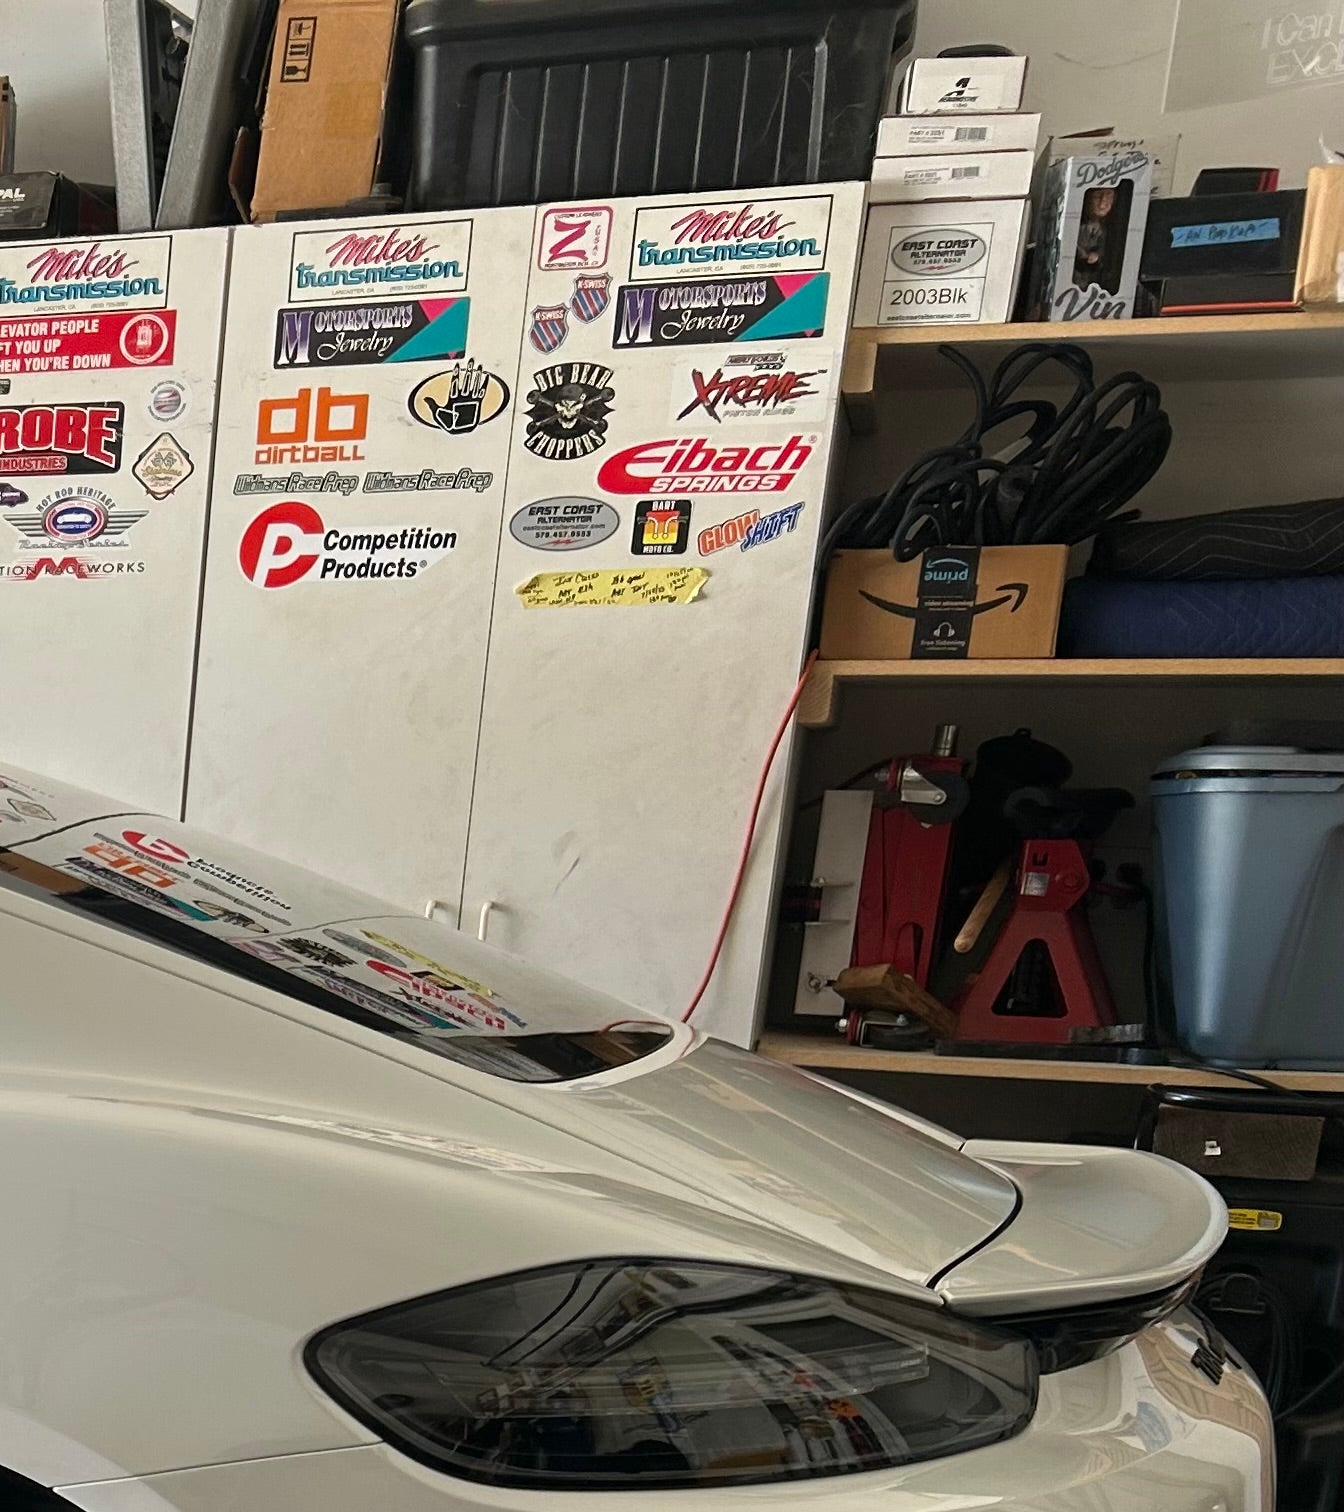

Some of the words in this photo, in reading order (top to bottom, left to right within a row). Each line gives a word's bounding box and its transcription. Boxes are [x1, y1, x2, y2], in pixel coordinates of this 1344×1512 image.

[670, 204, 796, 245] Mike's
[326, 228, 440, 267] Mike's
[547, 220, 591, 263] Z
[638, 235, 823, 267] transmission
[902, 241, 934, 251] EAST
[937, 239, 978, 250] COAST
[911, 249, 966, 258] ALTERNATOR
[27, 243, 140, 283] Mike's
[296, 257, 463, 289] transmission
[578, 279, 608, 289] K-SWISS
[890, 287, 968, 305] 2003Blk
[535, 309, 565, 321] K-SWISS
[617, 281, 767, 345] MOTORSPORTS
[1054, 284, 1126, 320] Vin
[52, 319, 100, 334] PEOPLE
[279, 304, 413, 365] MOTORSPORTS
[660, 309, 745, 340] Jewelry
[15, 341, 40, 354] YOU
[43, 339, 61, 353] UP
[316, 331, 394, 361] Jewelry
[23, 356, 70, 371] YOU'RE
[72, 353, 111, 368] DOWN
[535, 366, 562, 391] BIG
[570, 364, 609, 390] BEAR
[677, 368, 822, 423] XTREME
[257, 387, 370, 444] db
[723, 409, 759, 418] PISTON
[527, 429, 605, 459] CHOPPERS
[0, 456, 67, 471] INDUSTRIES
[597, 435, 813, 494] Eibach
[287, 471, 322, 492] Race
[321, 470, 360, 496] Prep
[417, 469, 456, 491] Race
[455, 467, 493, 493] Prep
[650, 475, 780, 493] SPRINGS
[36, 495, 53, 512] HOT
[55, 487, 74, 496] ROD
[77, 486, 117, 510] HERITAGE
[528, 506, 560, 516] EAST
[563, 505, 603, 515] COAST
[652, 501, 675, 511] DART
[537, 516, 592, 524] ALTERNATOR
[323, 527, 458, 556] Competition
[643, 545, 662, 553] MOTO
[320, 557, 418, 579] Products
[924, 568, 969, 584] prime
